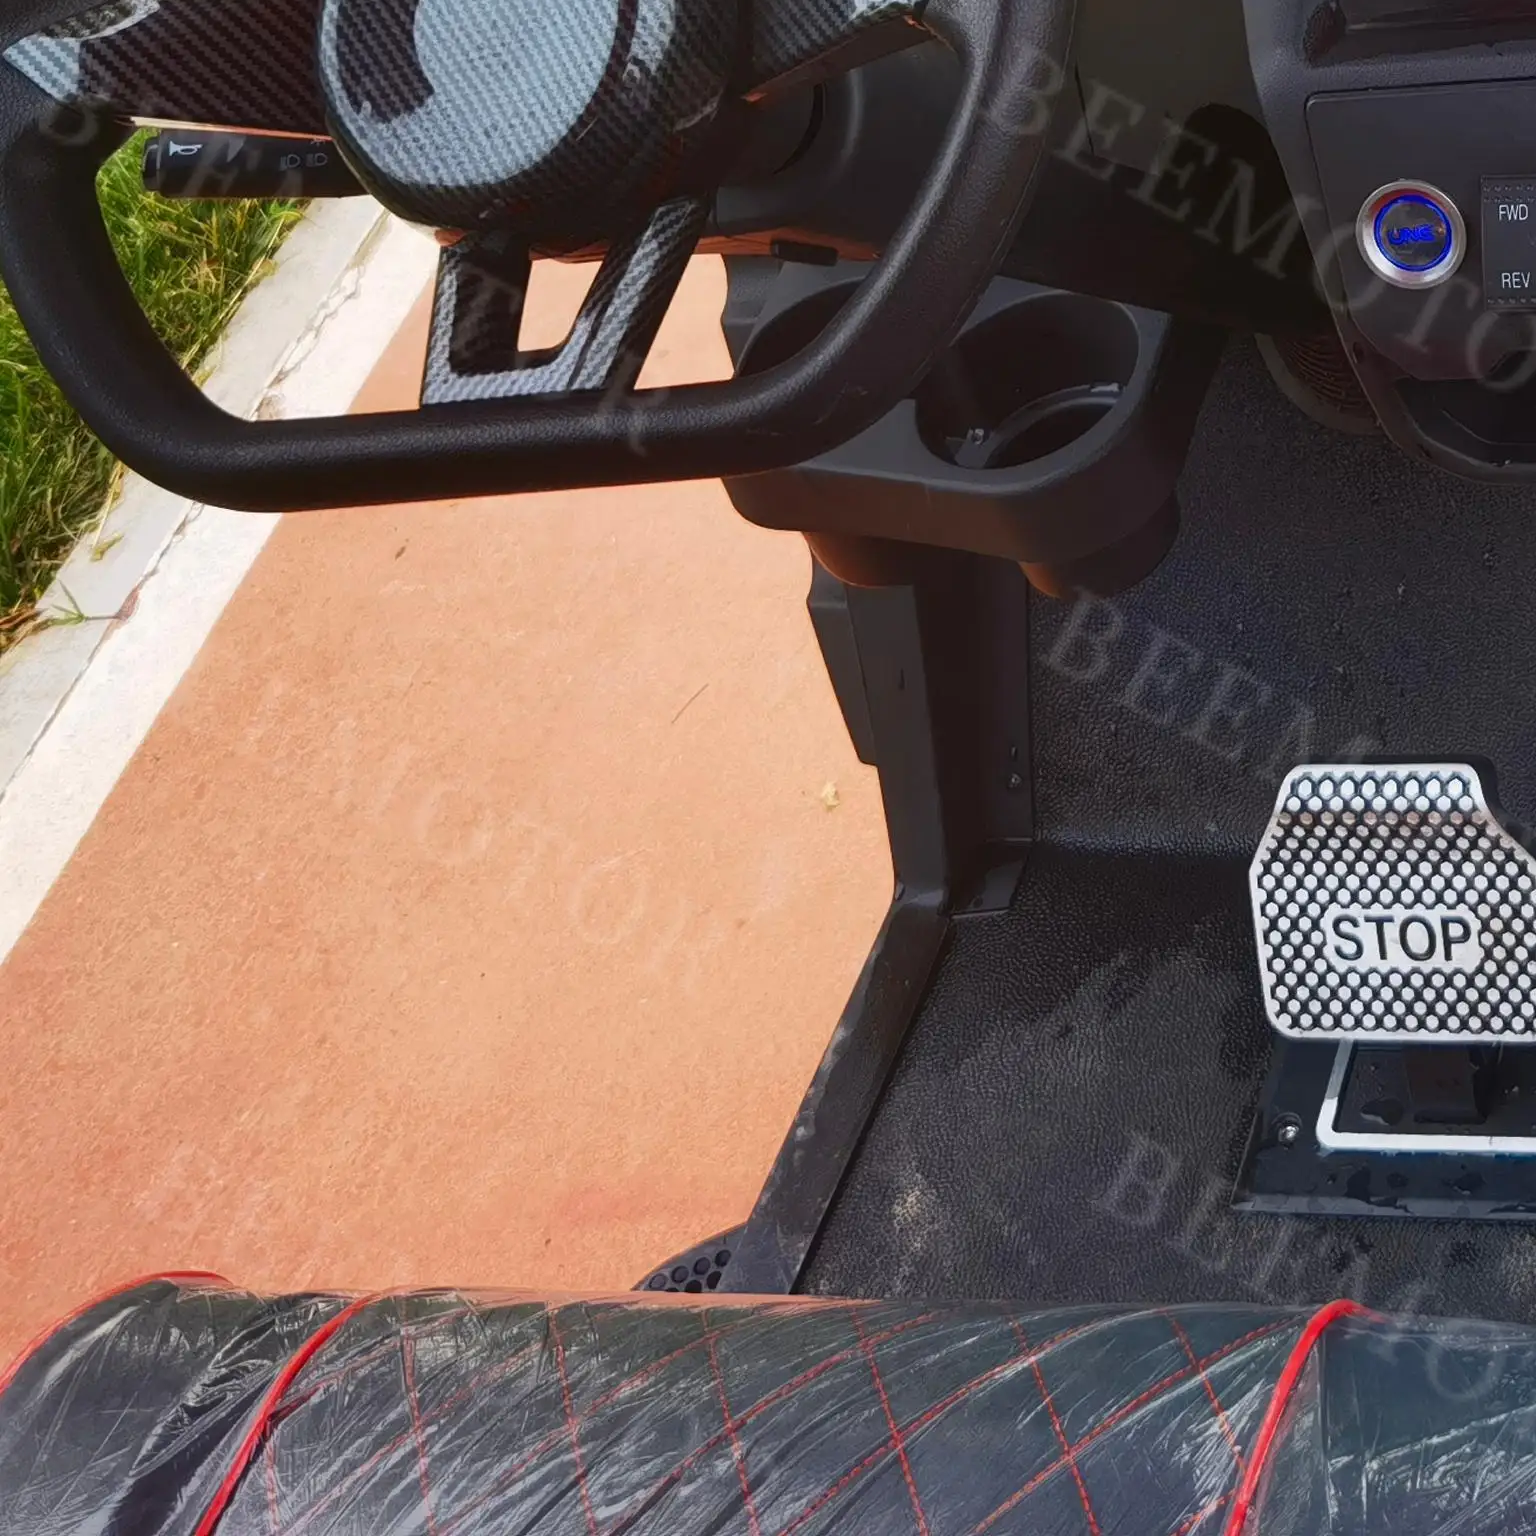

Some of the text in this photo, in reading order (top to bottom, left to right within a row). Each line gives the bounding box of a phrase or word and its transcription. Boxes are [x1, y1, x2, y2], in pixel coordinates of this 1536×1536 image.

[1499, 204, 1529, 221] FWD
[1501, 272, 1531, 289] REV
[1332, 915, 1473, 963] STOP
